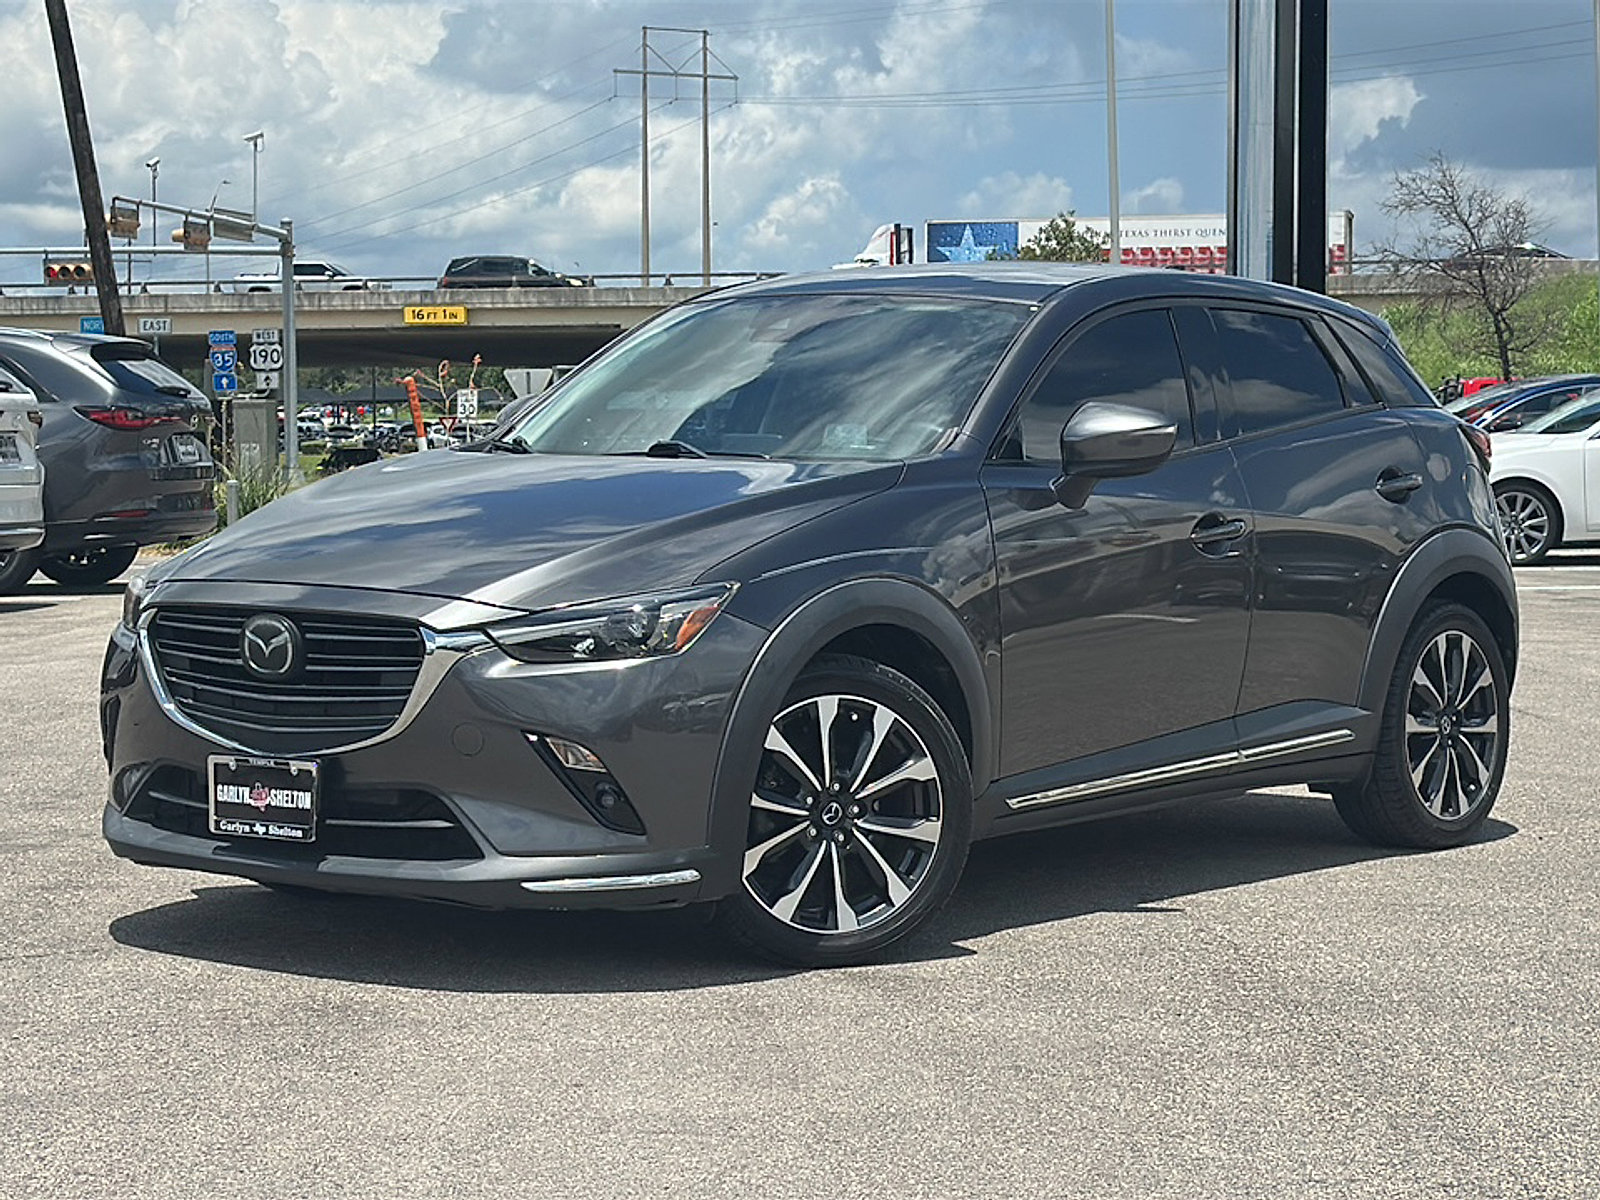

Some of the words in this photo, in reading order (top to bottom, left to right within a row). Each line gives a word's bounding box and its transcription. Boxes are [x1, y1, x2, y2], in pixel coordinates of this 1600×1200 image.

[1120, 229, 1150, 237] TEXAS
[1154, 228, 1191, 237] THIRST
[1196, 228, 1226, 237] QUEN
[411, 308, 425, 320] 16
[426, 311, 438, 320] FT
[442, 308, 448, 320] 1
[449, 311, 458, 320] IN
[83, 319, 105, 331] NOR
[143, 320, 168, 331] EAST
[209, 333, 235, 341] SOUTH
[256, 331, 275, 340] WEST
[252, 348, 280, 364] 190
[459, 403, 475, 415] 30
[216, 783, 251, 805] GARLYN
[269, 788, 312, 809] SHELTON
[219, 820, 250, 835] Garlyn
[268, 824, 303, 838] Shelton
